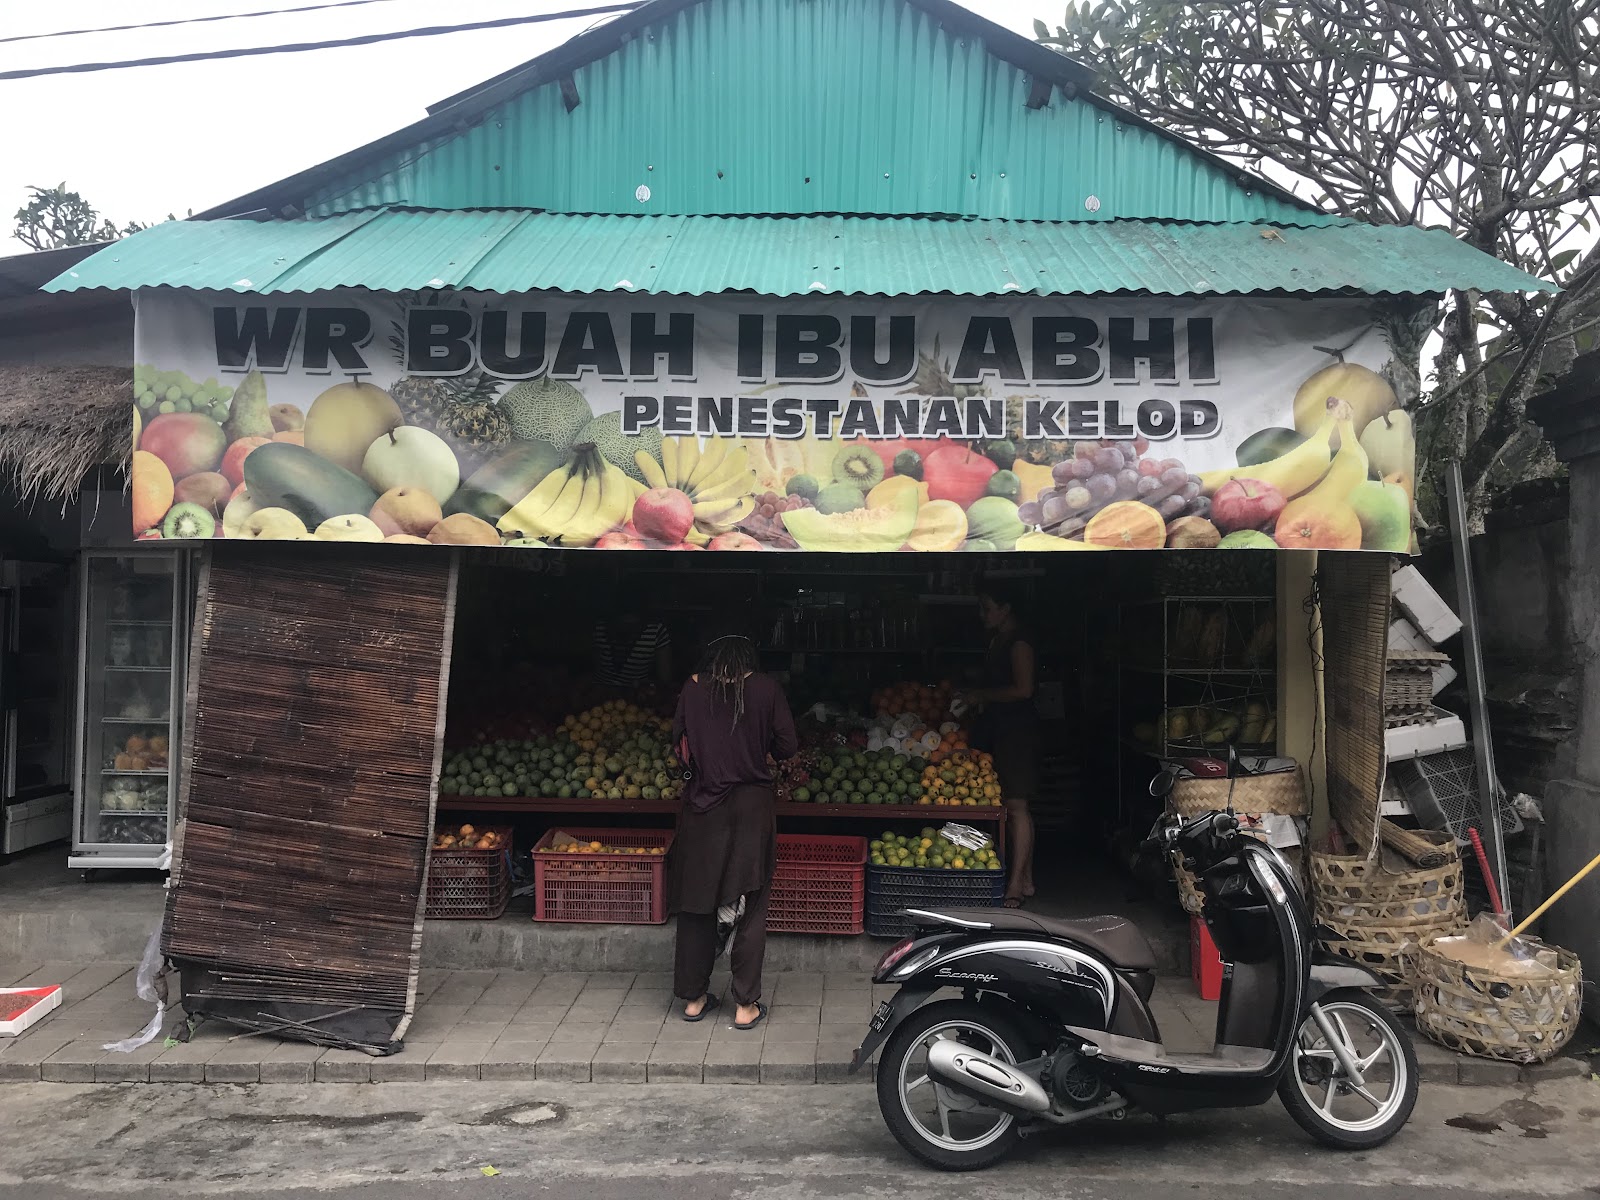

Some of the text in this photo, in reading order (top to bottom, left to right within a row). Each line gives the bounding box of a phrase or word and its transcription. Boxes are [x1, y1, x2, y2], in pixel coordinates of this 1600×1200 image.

[213, 306, 1219, 387] WR BUAH IBU ABHI
[620, 396, 1222, 440] PENESTANAN KELOD
